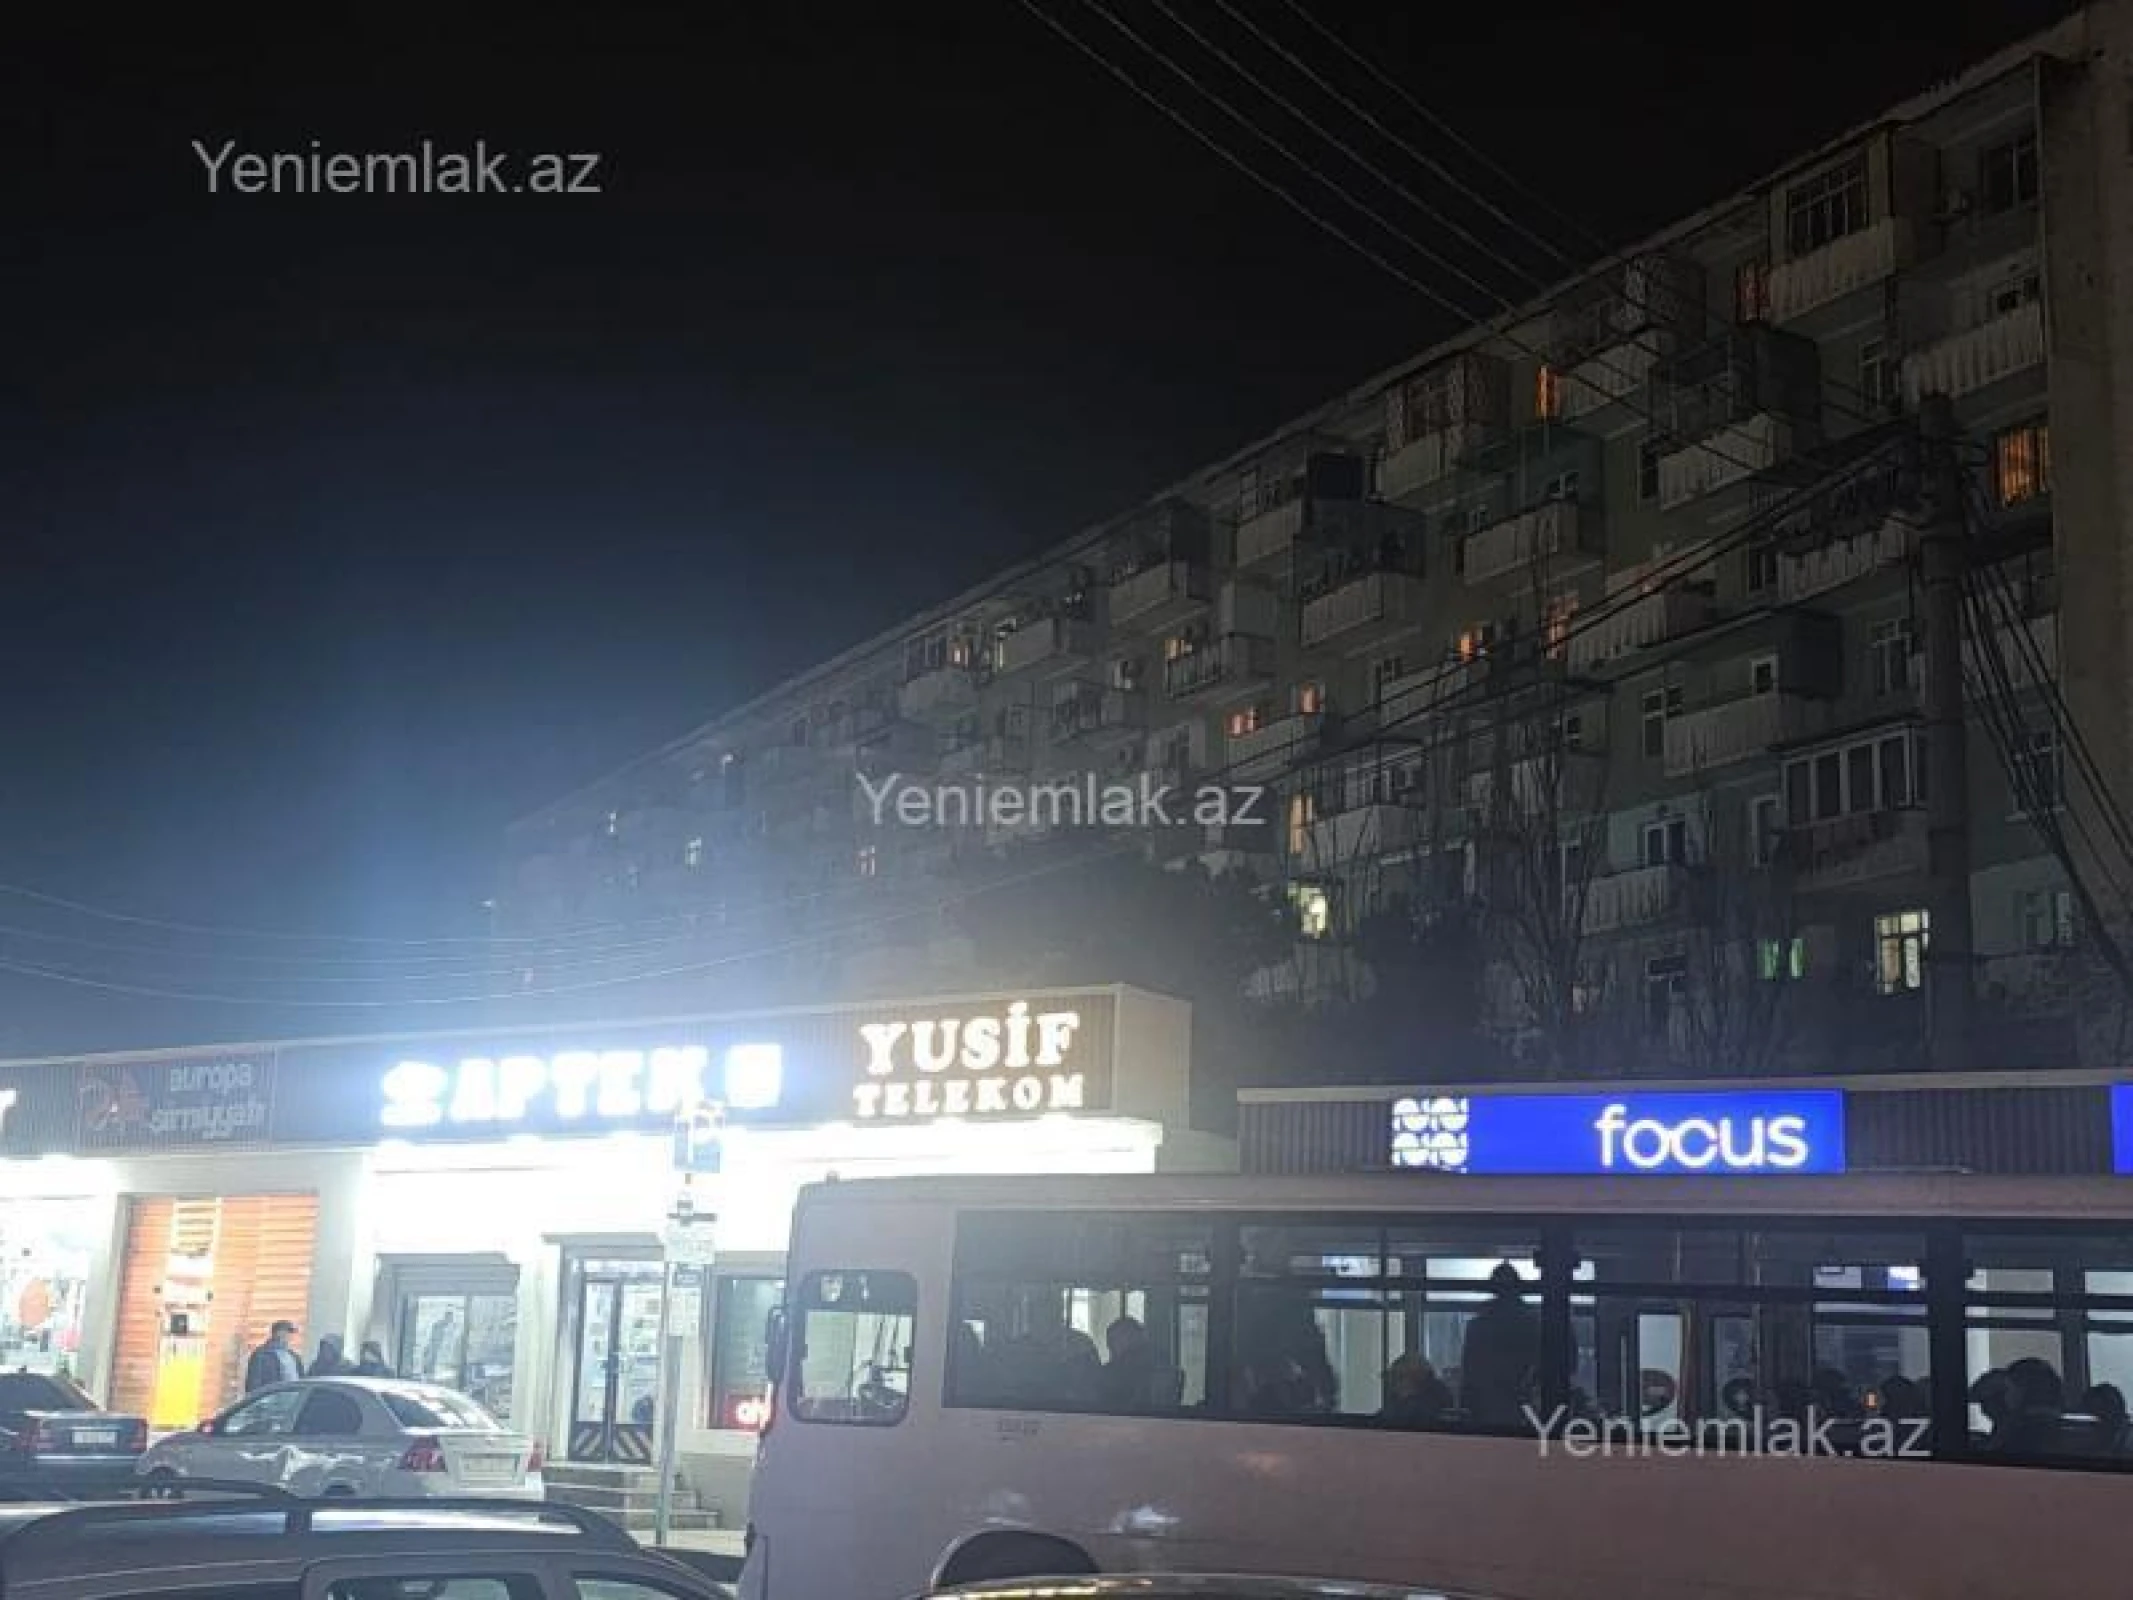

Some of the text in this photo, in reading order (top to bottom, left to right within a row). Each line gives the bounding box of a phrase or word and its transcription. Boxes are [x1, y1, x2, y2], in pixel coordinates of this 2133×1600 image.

[858, 1000, 1081, 1076] YUSİF
[852, 1074, 1084, 1118] TELEKOM
[1594, 1103, 1809, 1168] focus
